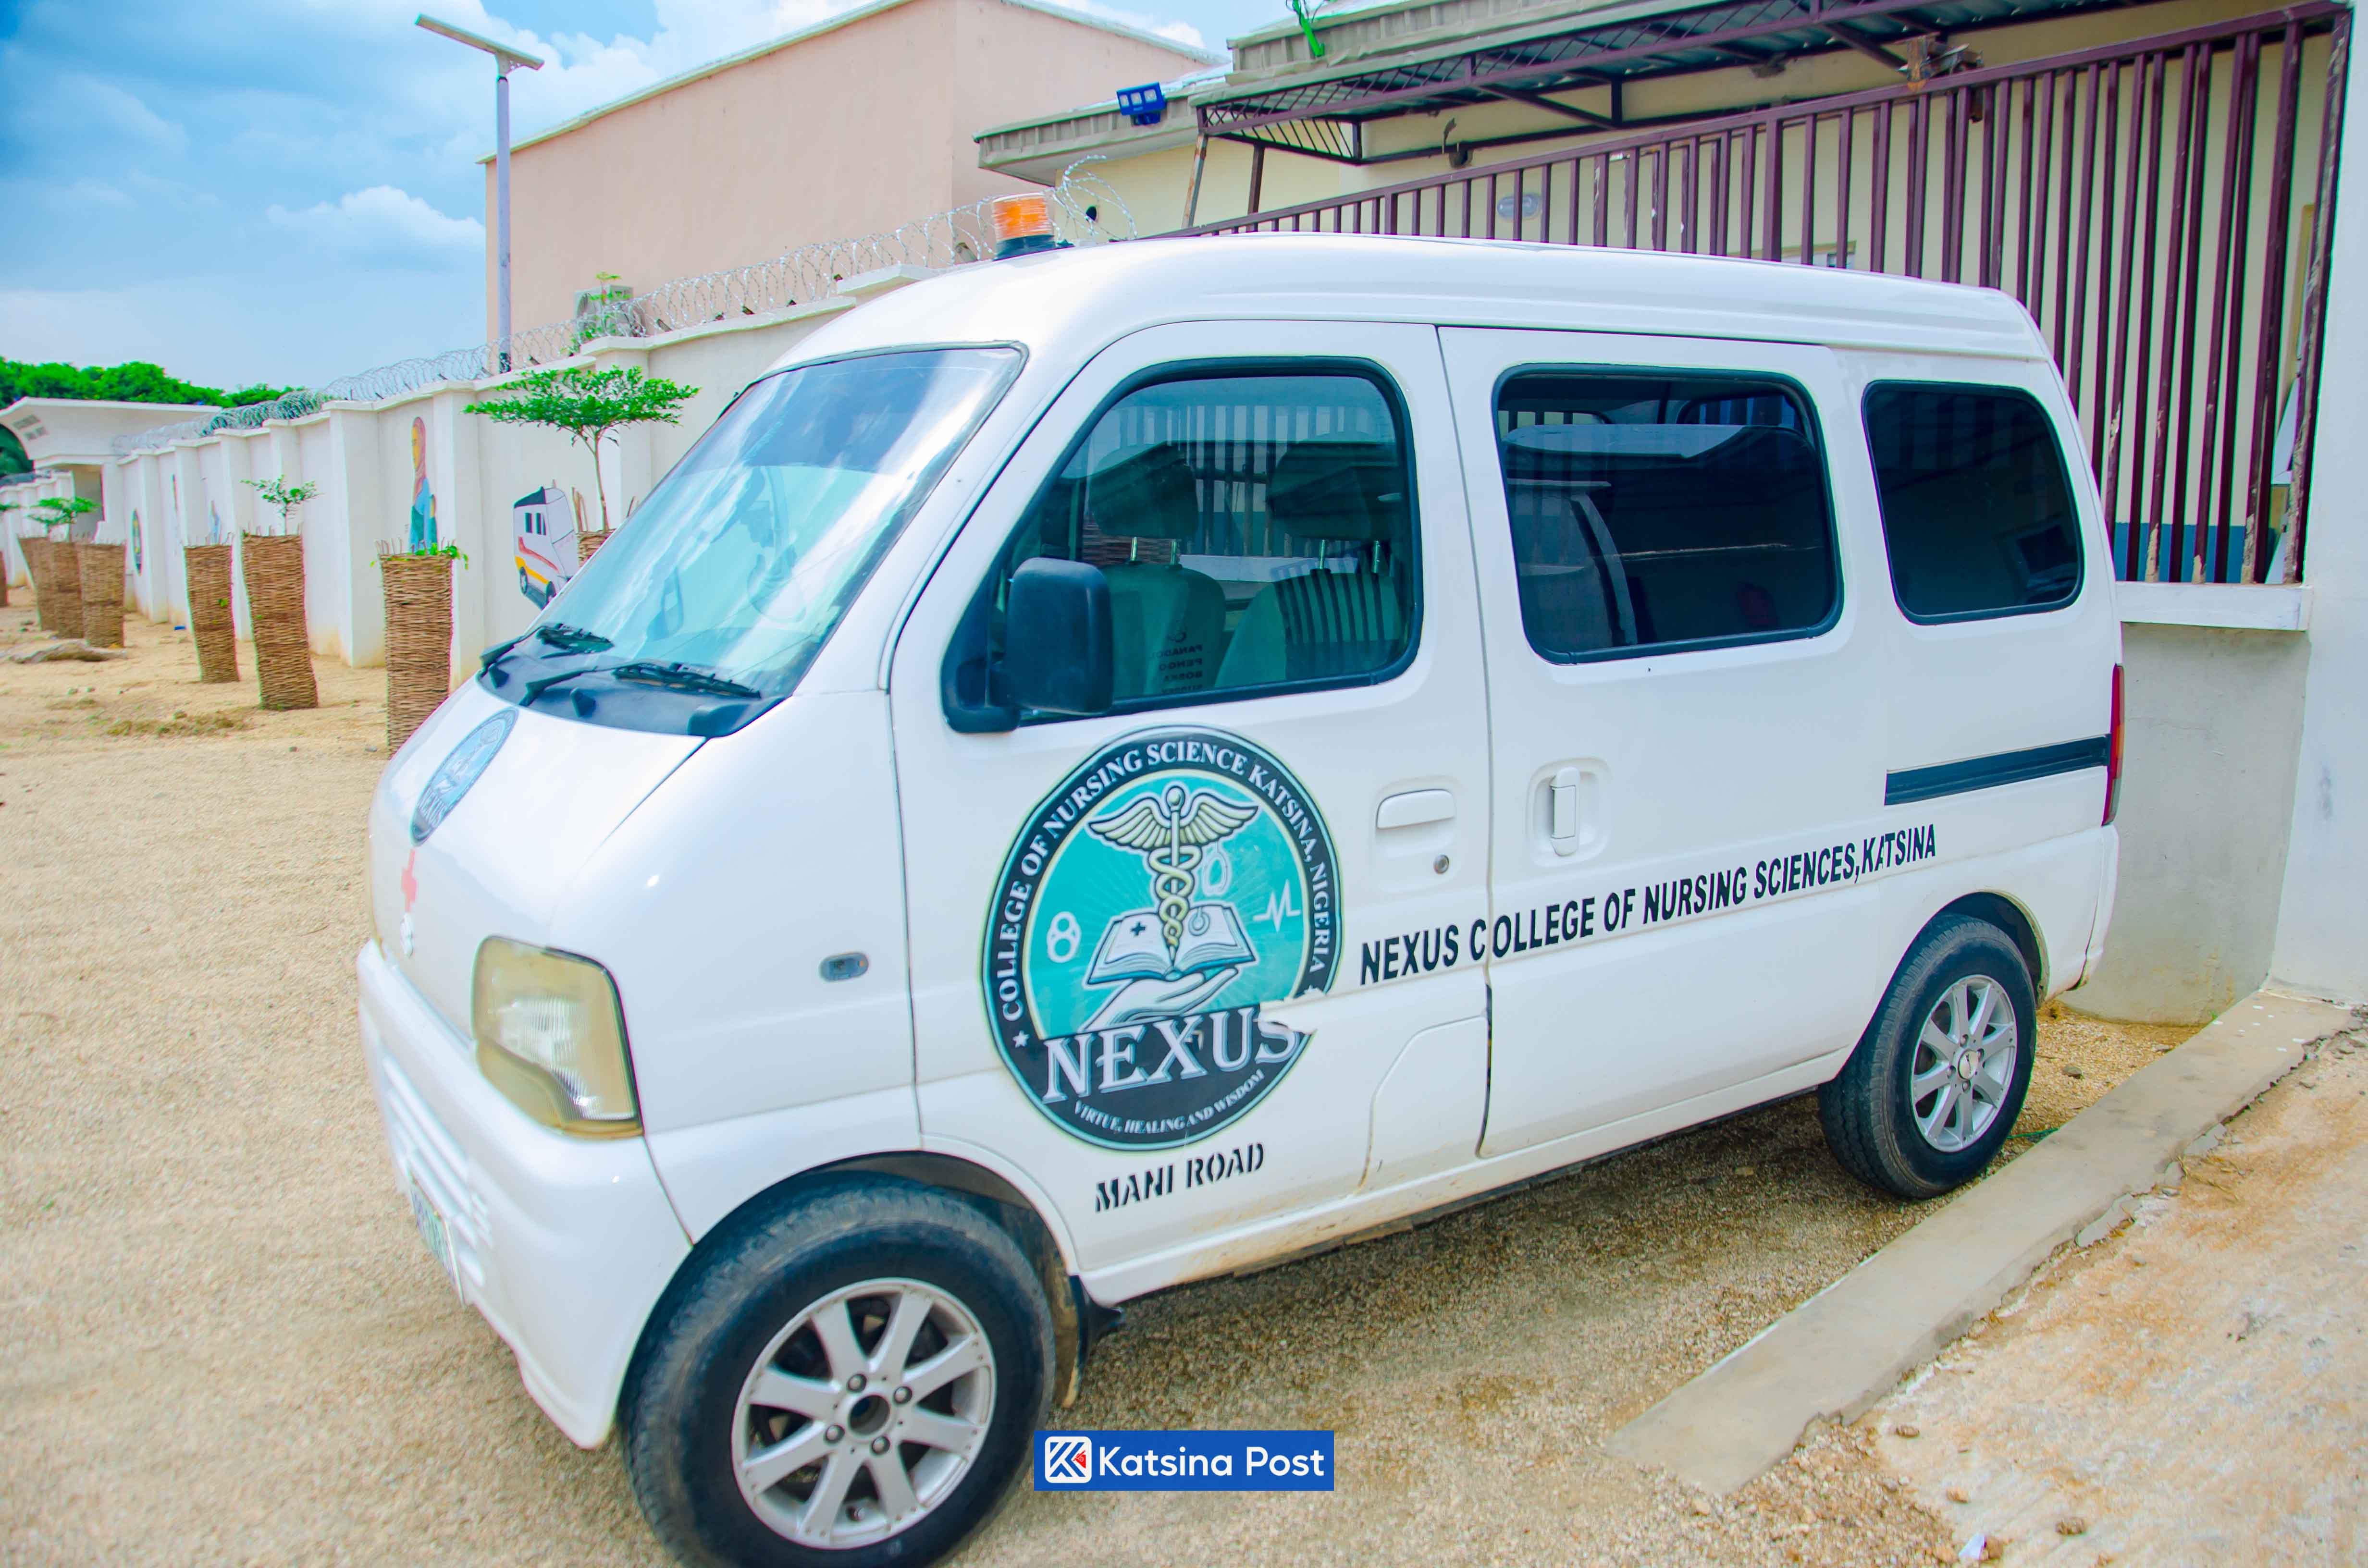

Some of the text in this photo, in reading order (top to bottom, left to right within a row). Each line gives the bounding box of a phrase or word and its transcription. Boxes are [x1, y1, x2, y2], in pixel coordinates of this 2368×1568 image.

[997, 741, 1331, 1022] COLLEGE OF NURSING SCIENCE KATSINA, NIGERIA
[1360, 924, 1459, 985] NEXUS
[1469, 896, 1595, 961] COLLEGE
[1603, 888, 1636, 932] OF
[1642, 866, 1747, 925] NURSING
[1042, 1007, 1299, 1104] NEXUS
[1124, 1115, 1185, 1134] HEALING
[1186, 1106, 1215, 1127] AND
[1213, 1068, 1265, 1113] WISDOM
[1095, 1142, 1264, 1213] MANI ROAD
